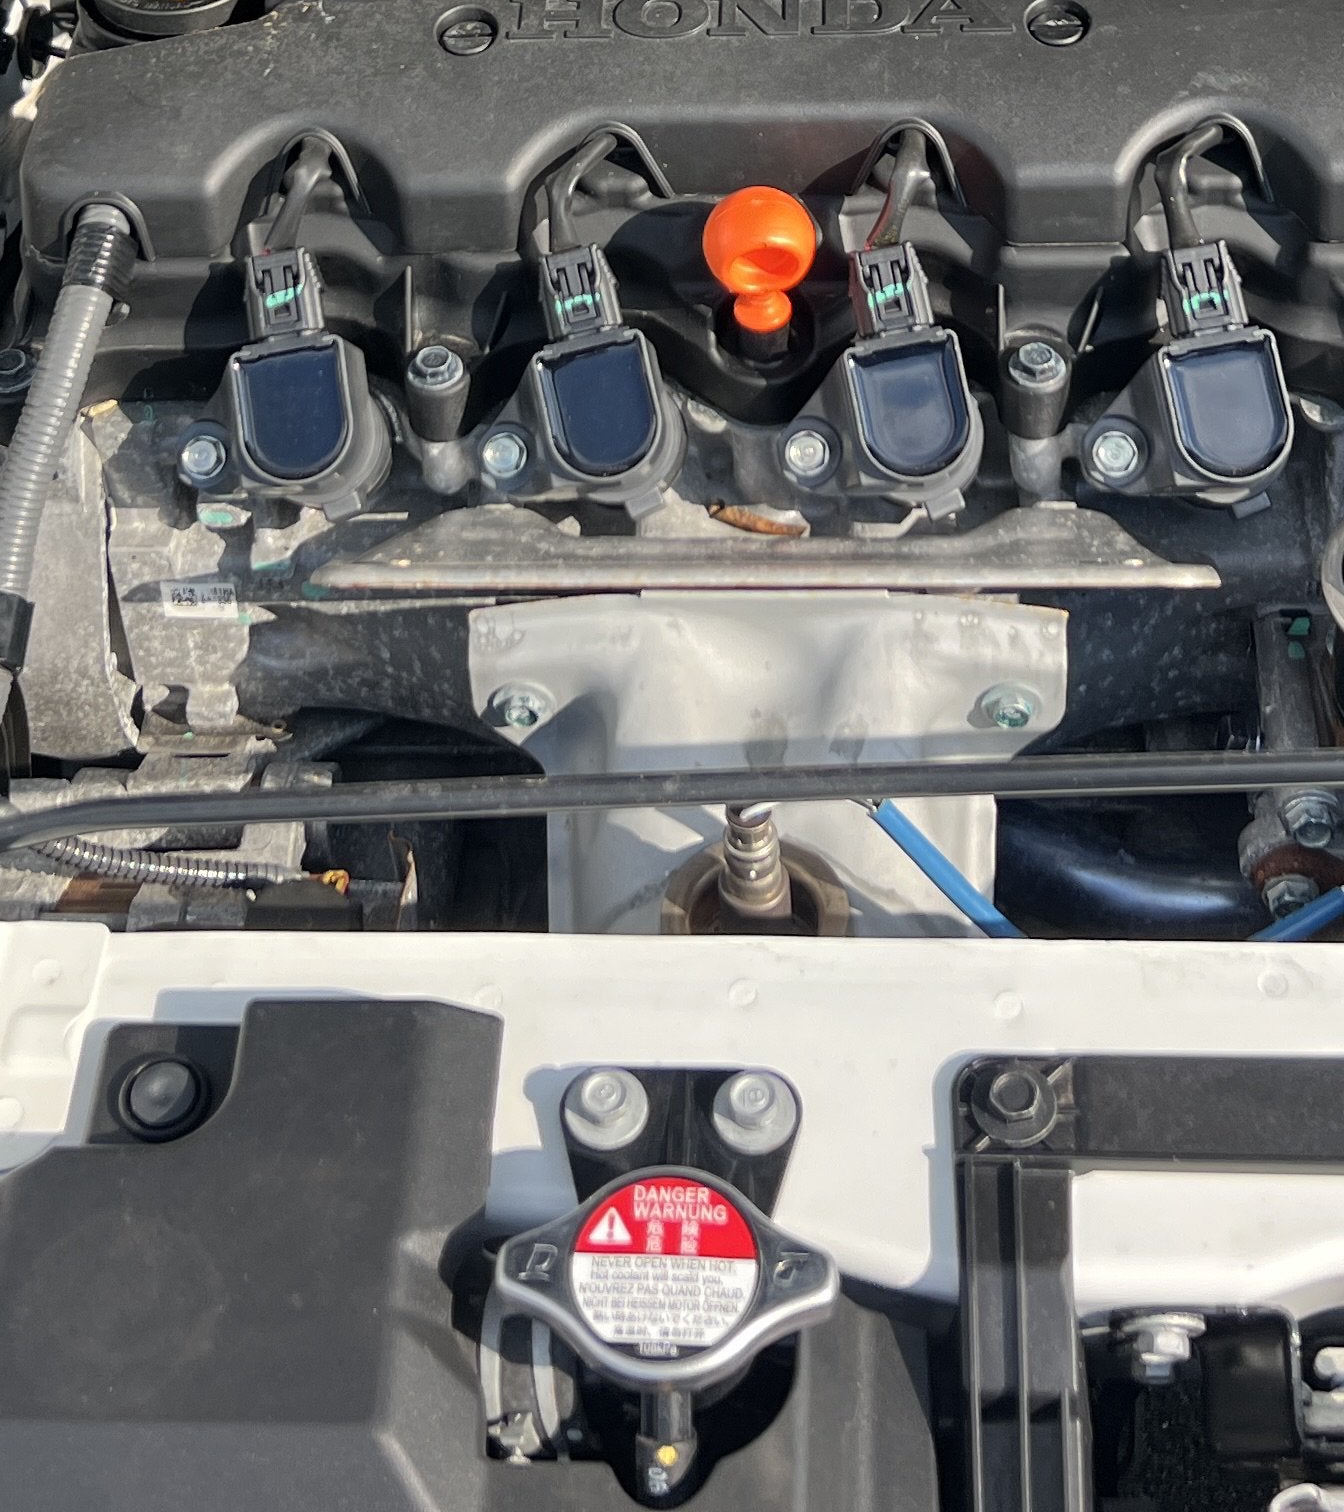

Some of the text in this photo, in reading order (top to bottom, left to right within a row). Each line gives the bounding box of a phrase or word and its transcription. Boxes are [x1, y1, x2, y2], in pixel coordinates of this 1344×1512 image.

[633, 1184, 710, 1203] DANGER
[633, 1202, 729, 1222] WARNUNG
[591, 1256, 632, 1268] NEVER
[635, 1257, 668, 1269] OPEN
[671, 1258, 706, 1270] WHEN
[637, 1283, 659, 1295] PAS
[662, 1285, 701, 1297] QUAND
